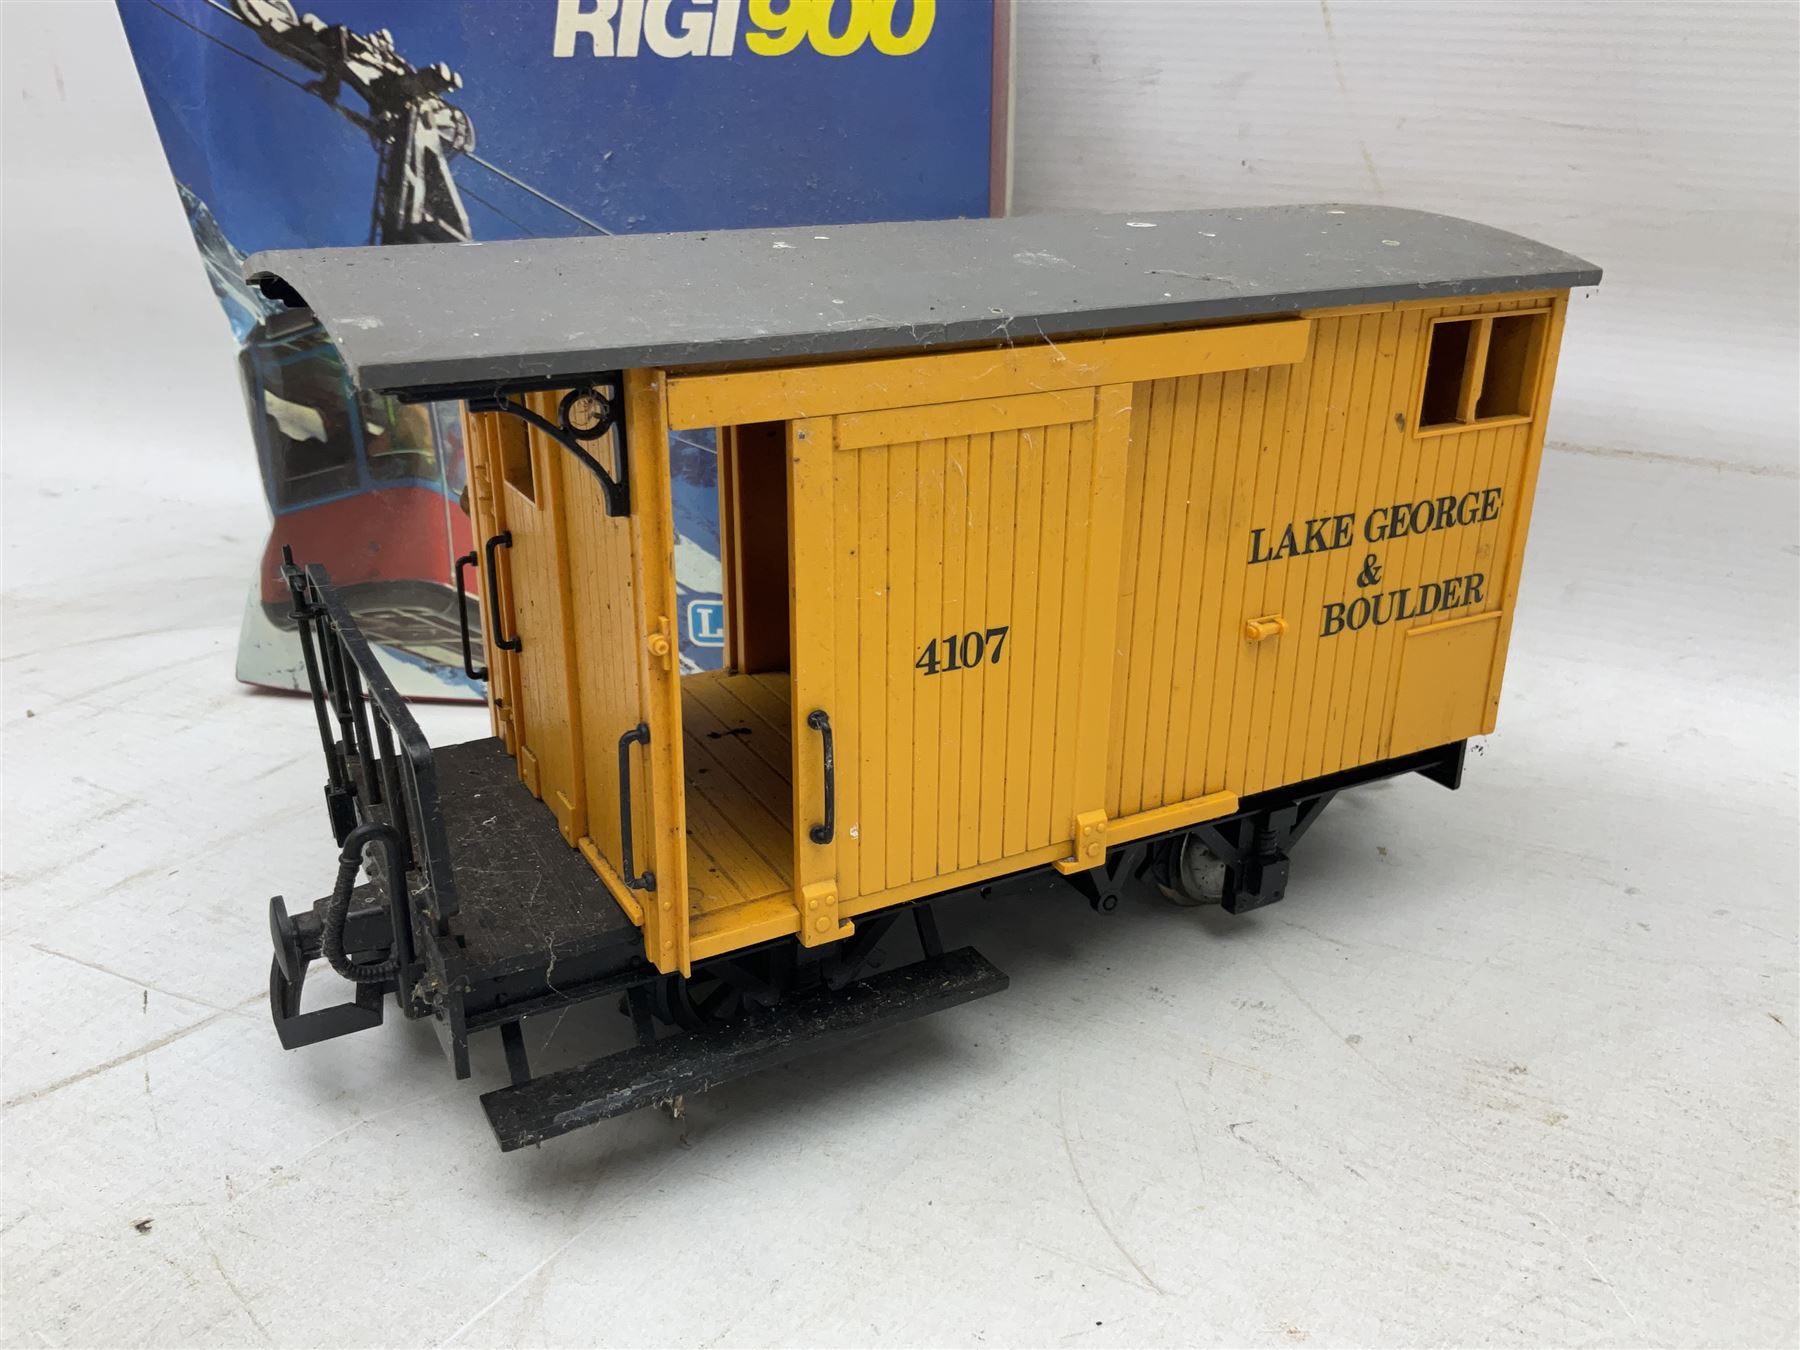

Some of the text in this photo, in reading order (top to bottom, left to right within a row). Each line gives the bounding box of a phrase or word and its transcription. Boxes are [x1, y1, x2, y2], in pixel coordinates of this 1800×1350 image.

[1247, 487, 1502, 565] LAKE GEORGE
[1356, 553, 1382, 588] &
[1319, 572, 1485, 637] BOULDER
[915, 625, 1009, 676] 4107
